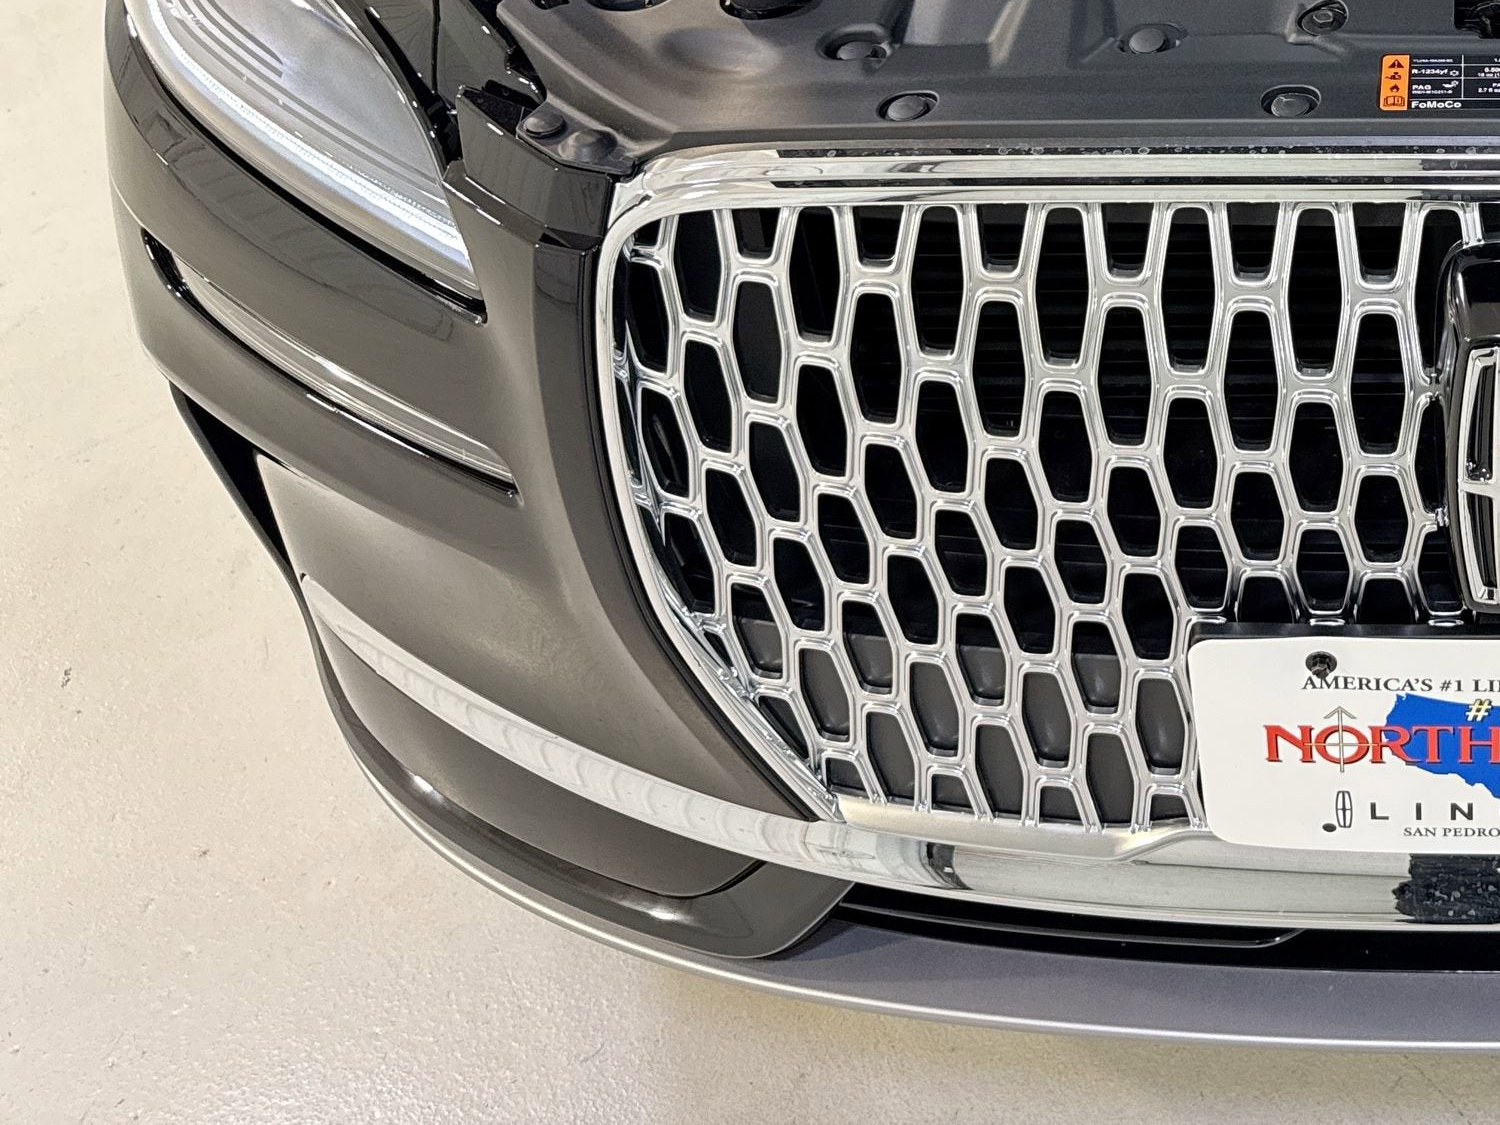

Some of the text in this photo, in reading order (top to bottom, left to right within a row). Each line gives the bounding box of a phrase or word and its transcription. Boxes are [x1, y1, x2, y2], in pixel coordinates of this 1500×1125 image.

[1301, 675, 1434, 692] AMERICA'S
[1439, 678, 1463, 692] #1
[1402, 827, 1438, 838] SAN
[1441, 827, 1500, 838] PEDRO
